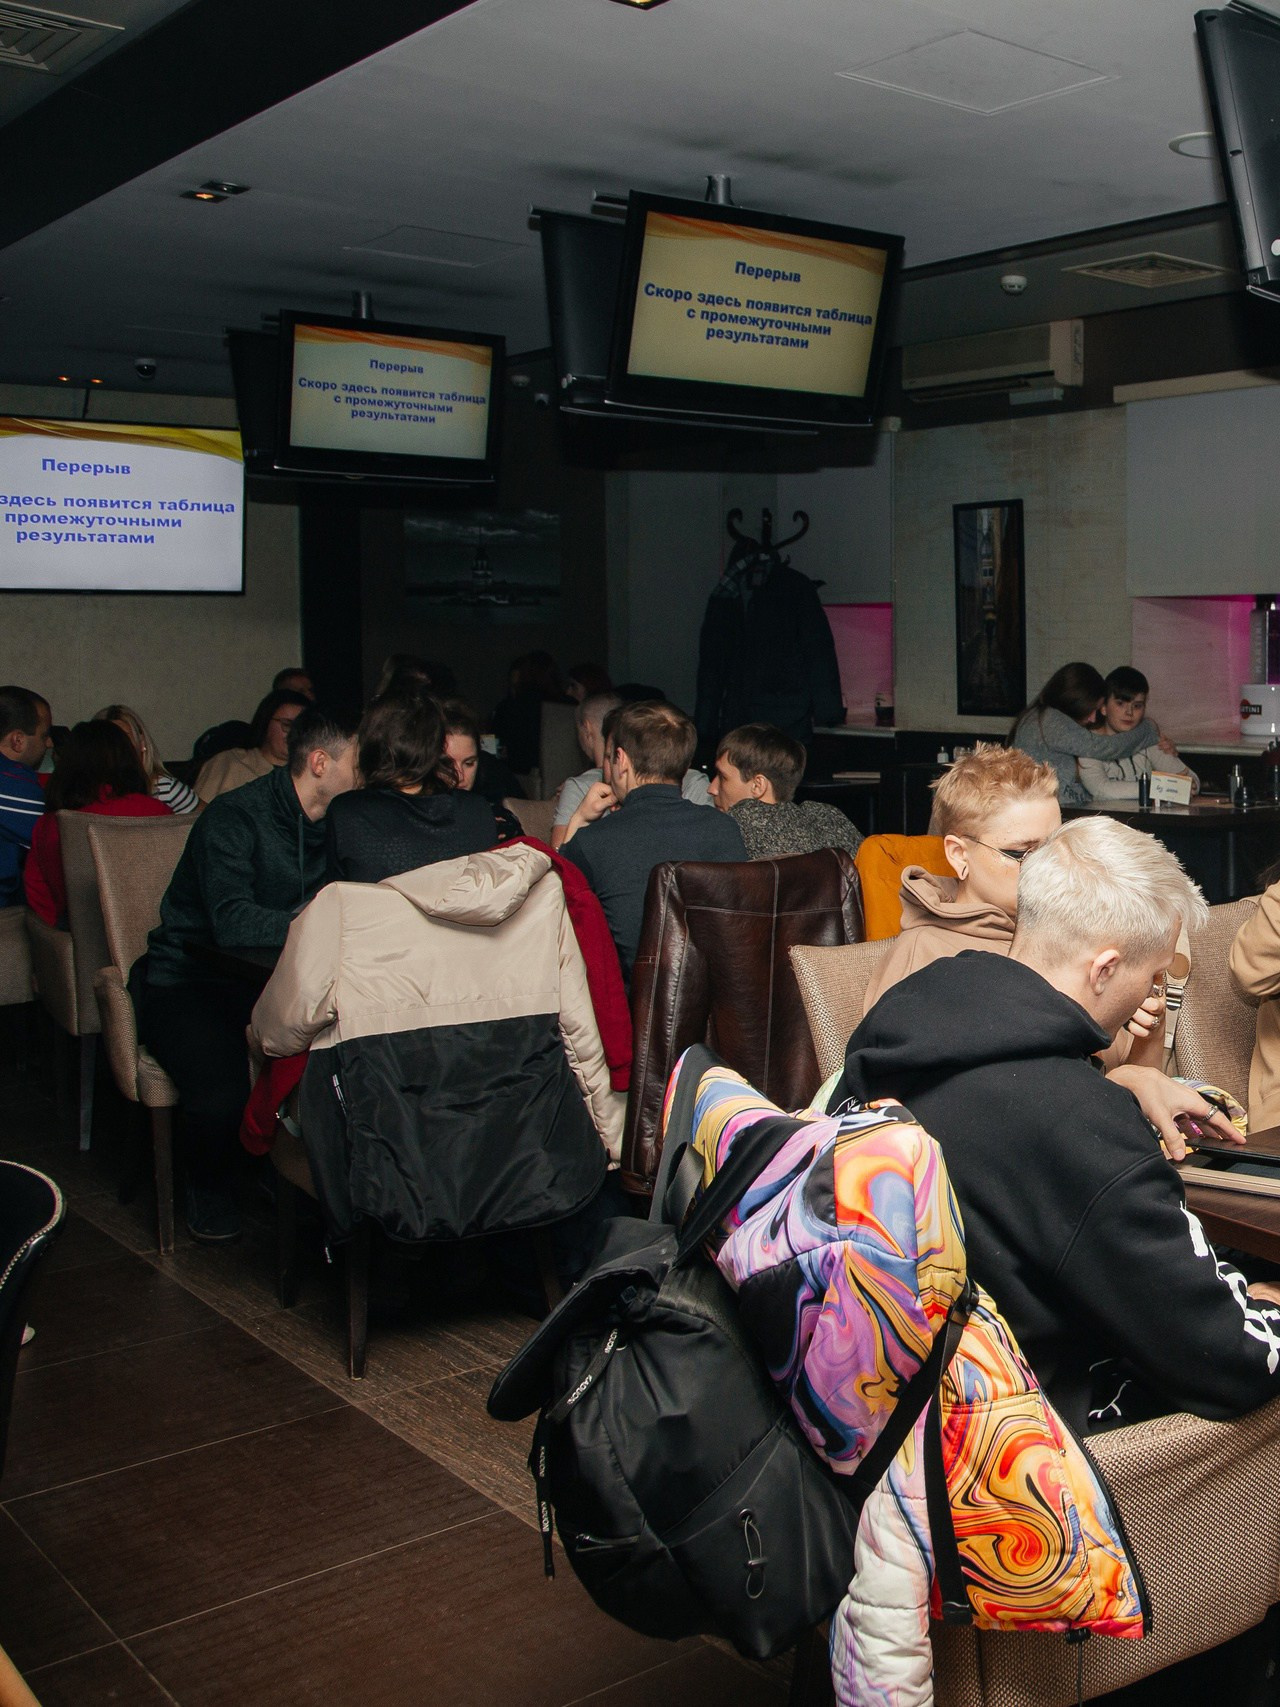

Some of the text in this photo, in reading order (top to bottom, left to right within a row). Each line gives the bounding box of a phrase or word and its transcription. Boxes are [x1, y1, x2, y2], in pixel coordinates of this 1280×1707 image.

[735, 261, 801, 283] Перерыв
[644, 283, 872, 325] Скоро здесь появится таблица
[687, 308, 831, 335] с промежуточными
[706, 327, 809, 349] результатами
[369, 359, 424, 374] Перерыв
[298, 377, 486, 405] Скоро здесь появится таблица
[334, 395, 453, 413] с промежуточными
[351, 409, 436, 424] результатами
[41, 458, 131, 476] Перерыв
[0, 495, 235, 515] здесь появится таблица
[5, 513, 182, 528] промежуточными
[16, 531, 155, 545] результатами
